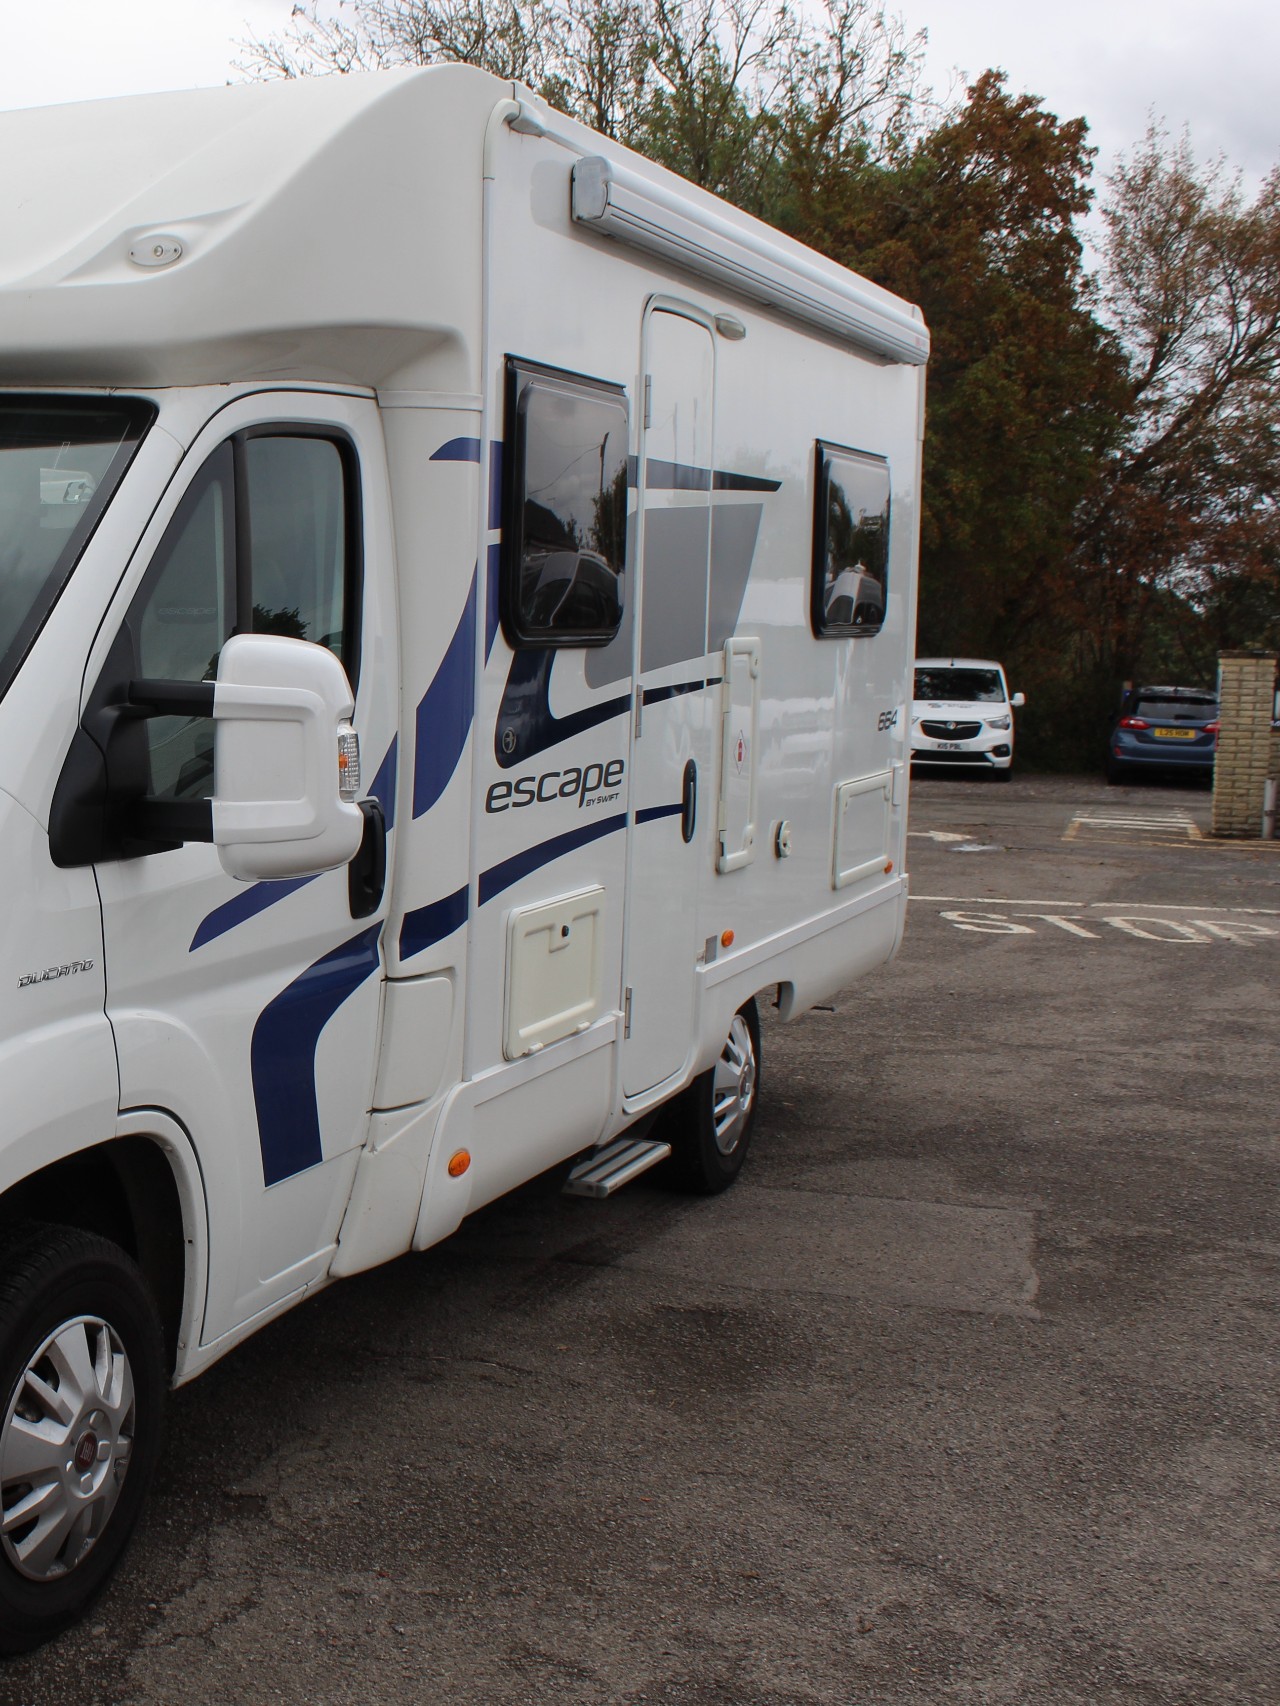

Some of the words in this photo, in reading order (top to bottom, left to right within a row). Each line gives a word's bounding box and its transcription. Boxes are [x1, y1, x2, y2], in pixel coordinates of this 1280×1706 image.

[877, 709, 898, 732] 664
[485, 759, 625, 814] escape
[586, 798, 596, 807] BY
[596, 792, 620, 804] SWIFT
[939, 911, 1279, 947] STOP
